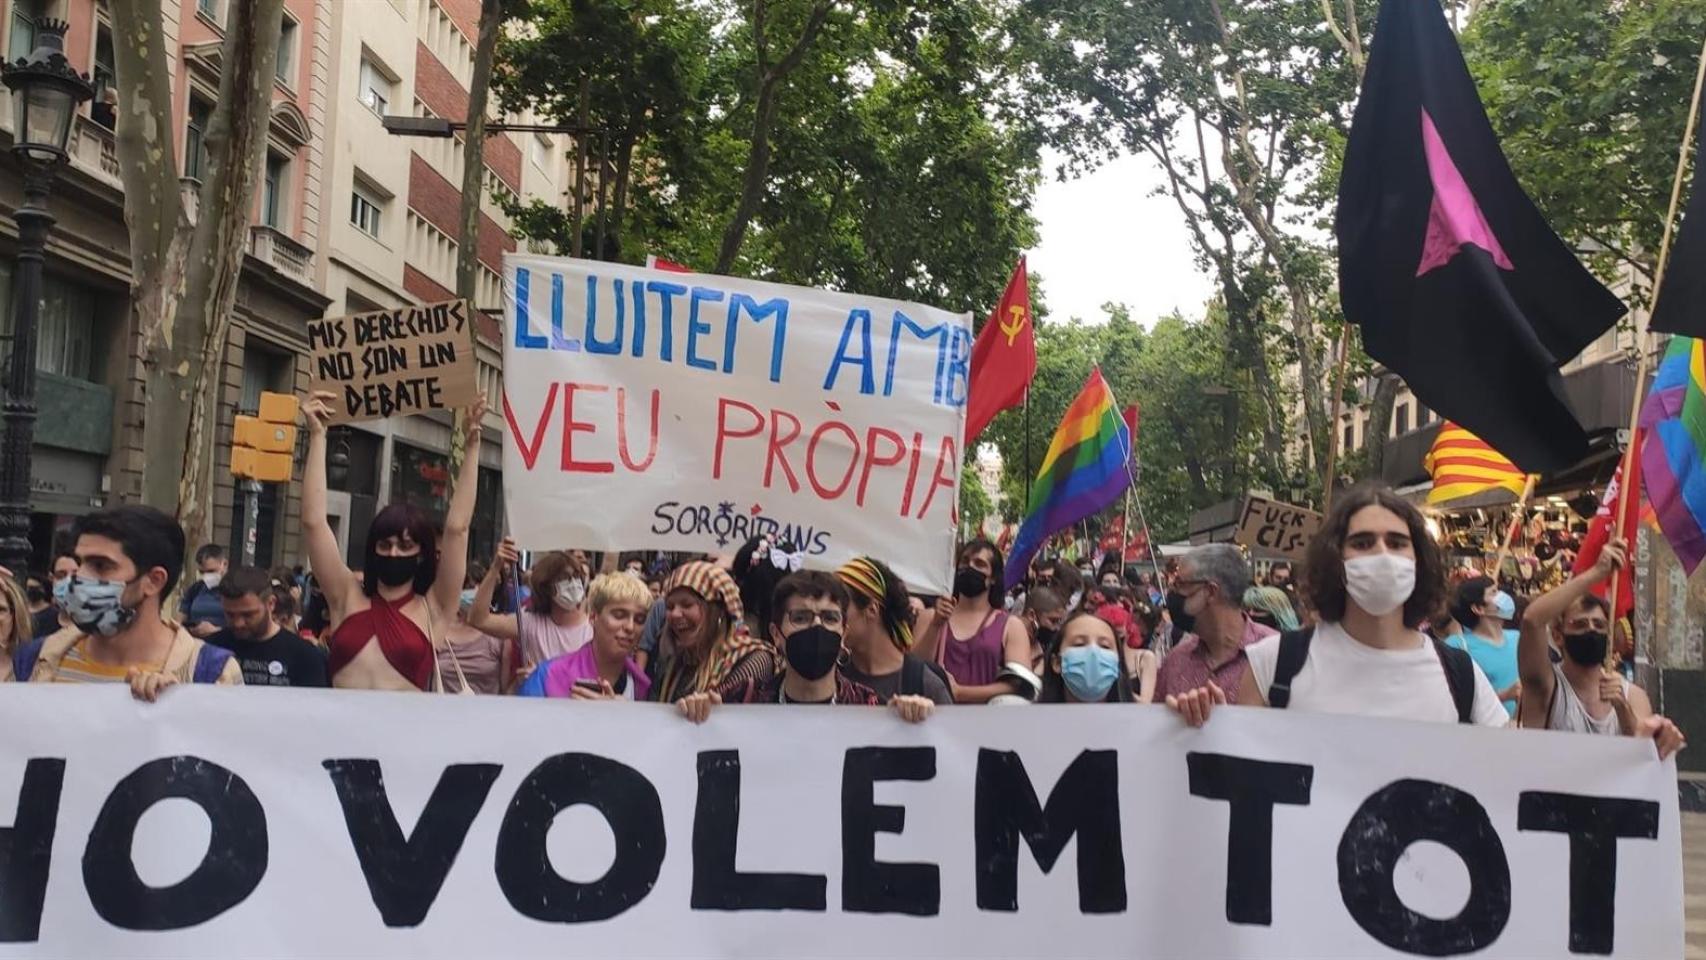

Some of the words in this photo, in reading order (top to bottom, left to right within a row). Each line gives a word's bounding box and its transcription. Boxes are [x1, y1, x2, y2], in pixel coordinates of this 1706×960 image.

[308, 320, 347, 350] MIS
[353, 301, 465, 347] DERECHOS
[513, 267, 790, 382] LLUITEM
[822, 309, 971, 406] AMB
[318, 352, 354, 381] NO
[361, 344, 407, 380] SON
[419, 342, 456, 368] UN
[344, 377, 444, 418] DEBATE
[502, 382, 660, 473] VEU
[712, 397, 959, 525] PRÒPIA
[1241, 497, 1306, 531] FUCK
[321, 746, 1128, 928] VOLEM
[1187, 749, 1660, 958] TOT
